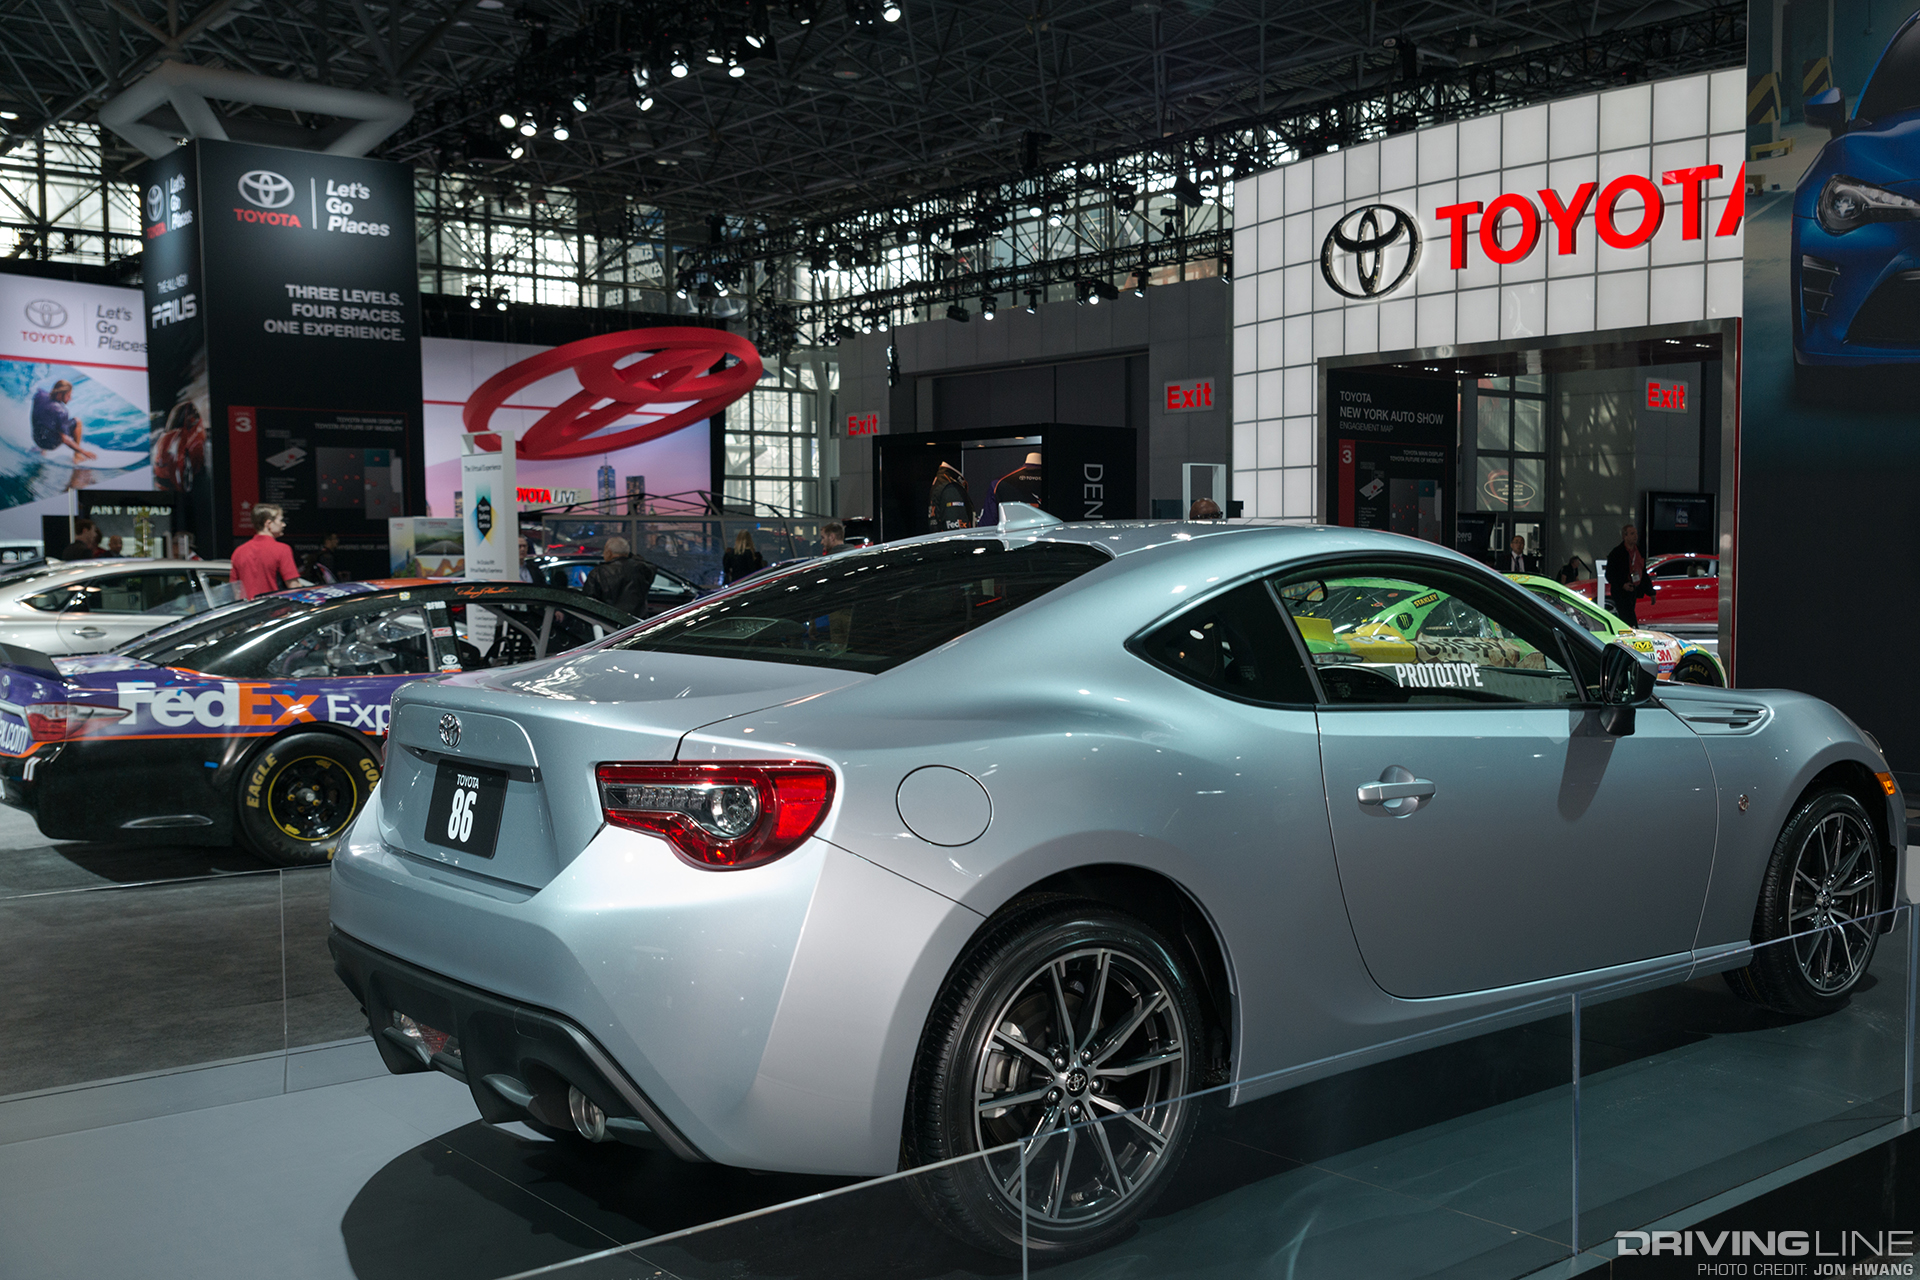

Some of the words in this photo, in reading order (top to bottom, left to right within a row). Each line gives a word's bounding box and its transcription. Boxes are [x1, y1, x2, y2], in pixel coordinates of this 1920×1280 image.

[326, 179, 371, 200] Let's
[325, 197, 354, 215] Go
[233, 208, 303, 228] TOYOTA
[327, 215, 391, 237] Places
[285, 283, 341, 301] THREE
[342, 289, 404, 306] LEVELS.
[96, 304, 133, 321] Let's
[151, 293, 198, 329] PRIUS
[291, 302, 338, 319] FOUR
[339, 306, 405, 324] SPACES.
[96, 320, 118, 334] Go
[263, 319, 301, 335] ONE
[302, 321, 407, 342] EXPERIENCE.
[21, 330, 76, 346] TOYOTA
[97, 335, 149, 353] Places
[1167, 382, 1212, 410] Exit
[1339, 390, 1372, 403] TOYOTA
[1648, 382, 1685, 410] Exit
[848, 413, 878, 436] Exit
[1339, 406, 1362, 419] NEW
[1363, 408, 1389, 421] YORK
[1390, 411, 1416, 423] AUTO
[1416, 412, 1444, 425] SHOW
[235, 417, 252, 433] 3
[1339, 420, 1380, 432] ENGAGEMENT
[1380, 424, 1394, 433] MAP
[1342, 449, 1352, 464] 3
[1403, 449, 1420, 457] TOYOTA
[89, 505, 122, 516] ANY
[946, 519, 967, 530] FedEx
[1413, 593, 1439, 608] STANLEY
[1656, 649, 1673, 662] 3M
[1395, 663, 1484, 688] PROTOTYPE
[1688, 664, 1709, 678] EAGLE
[117, 682, 320, 728] FedEx
[326, 695, 391, 736] Exp
[246, 752, 278, 809] EAGLE
[456, 773, 480, 790] TOYOTA
[447, 788, 478, 843] 86
